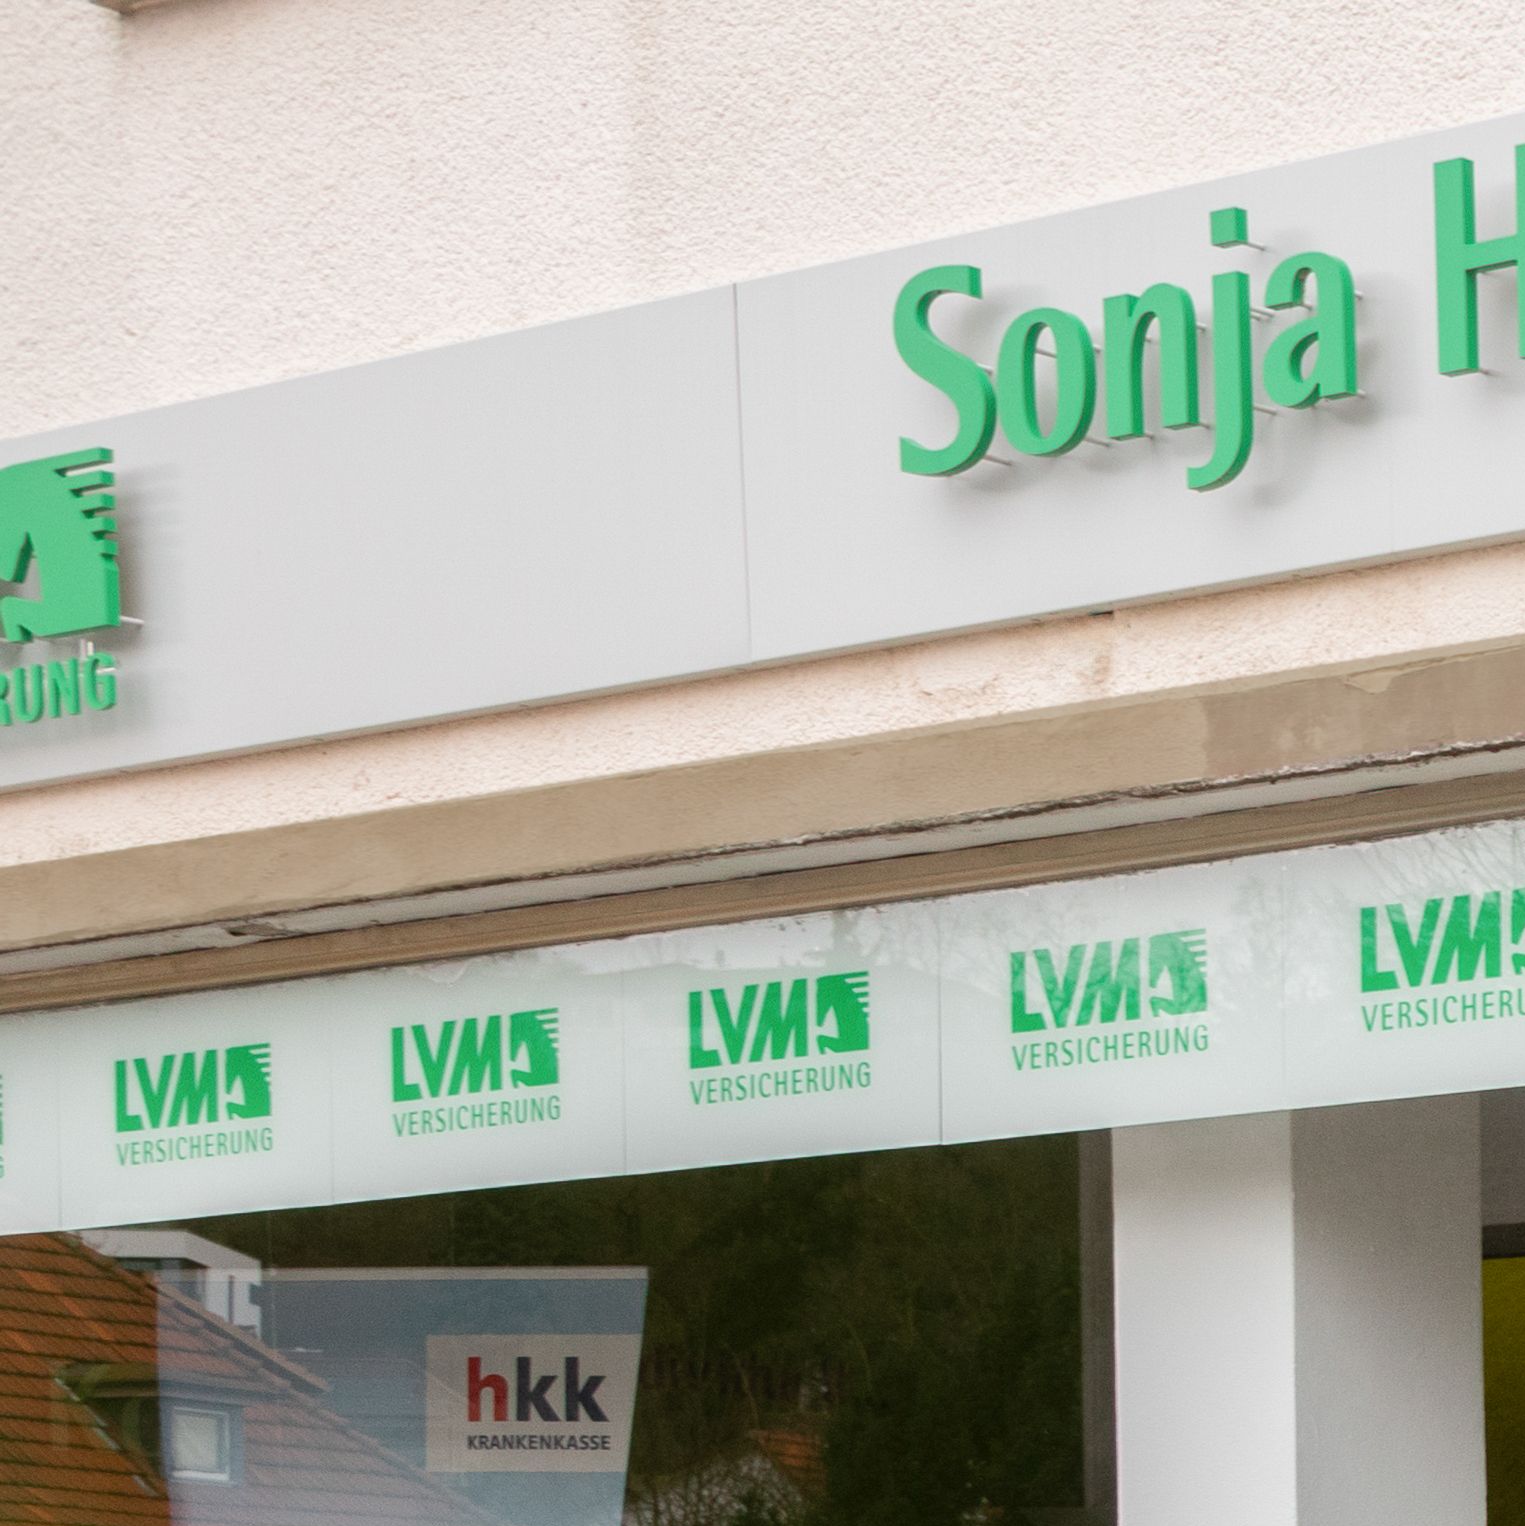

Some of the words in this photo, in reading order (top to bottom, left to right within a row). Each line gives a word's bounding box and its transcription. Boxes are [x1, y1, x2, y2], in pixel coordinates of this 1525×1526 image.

[893, 207, 1358, 492] Sonja
[1361, 890, 1501, 993] LVM
[1010, 936, 1140, 1034] LVM
[392, 1014, 503, 1102] LVM
[688, 978, 808, 1069] LVM
[1011, 1023, 1209, 1071] VERSICHERUNG
[115, 1049, 218, 1133] LVM
[392, 1094, 561, 1138] VERSICHERUNG
[689, 1061, 872, 1106] VERSICHERUNG
[117, 1126, 274, 1167] VERSICHERUNG
[467, 1356, 611, 1422] hkk
[467, 1434, 612, 1451] KRANKENKASSE
